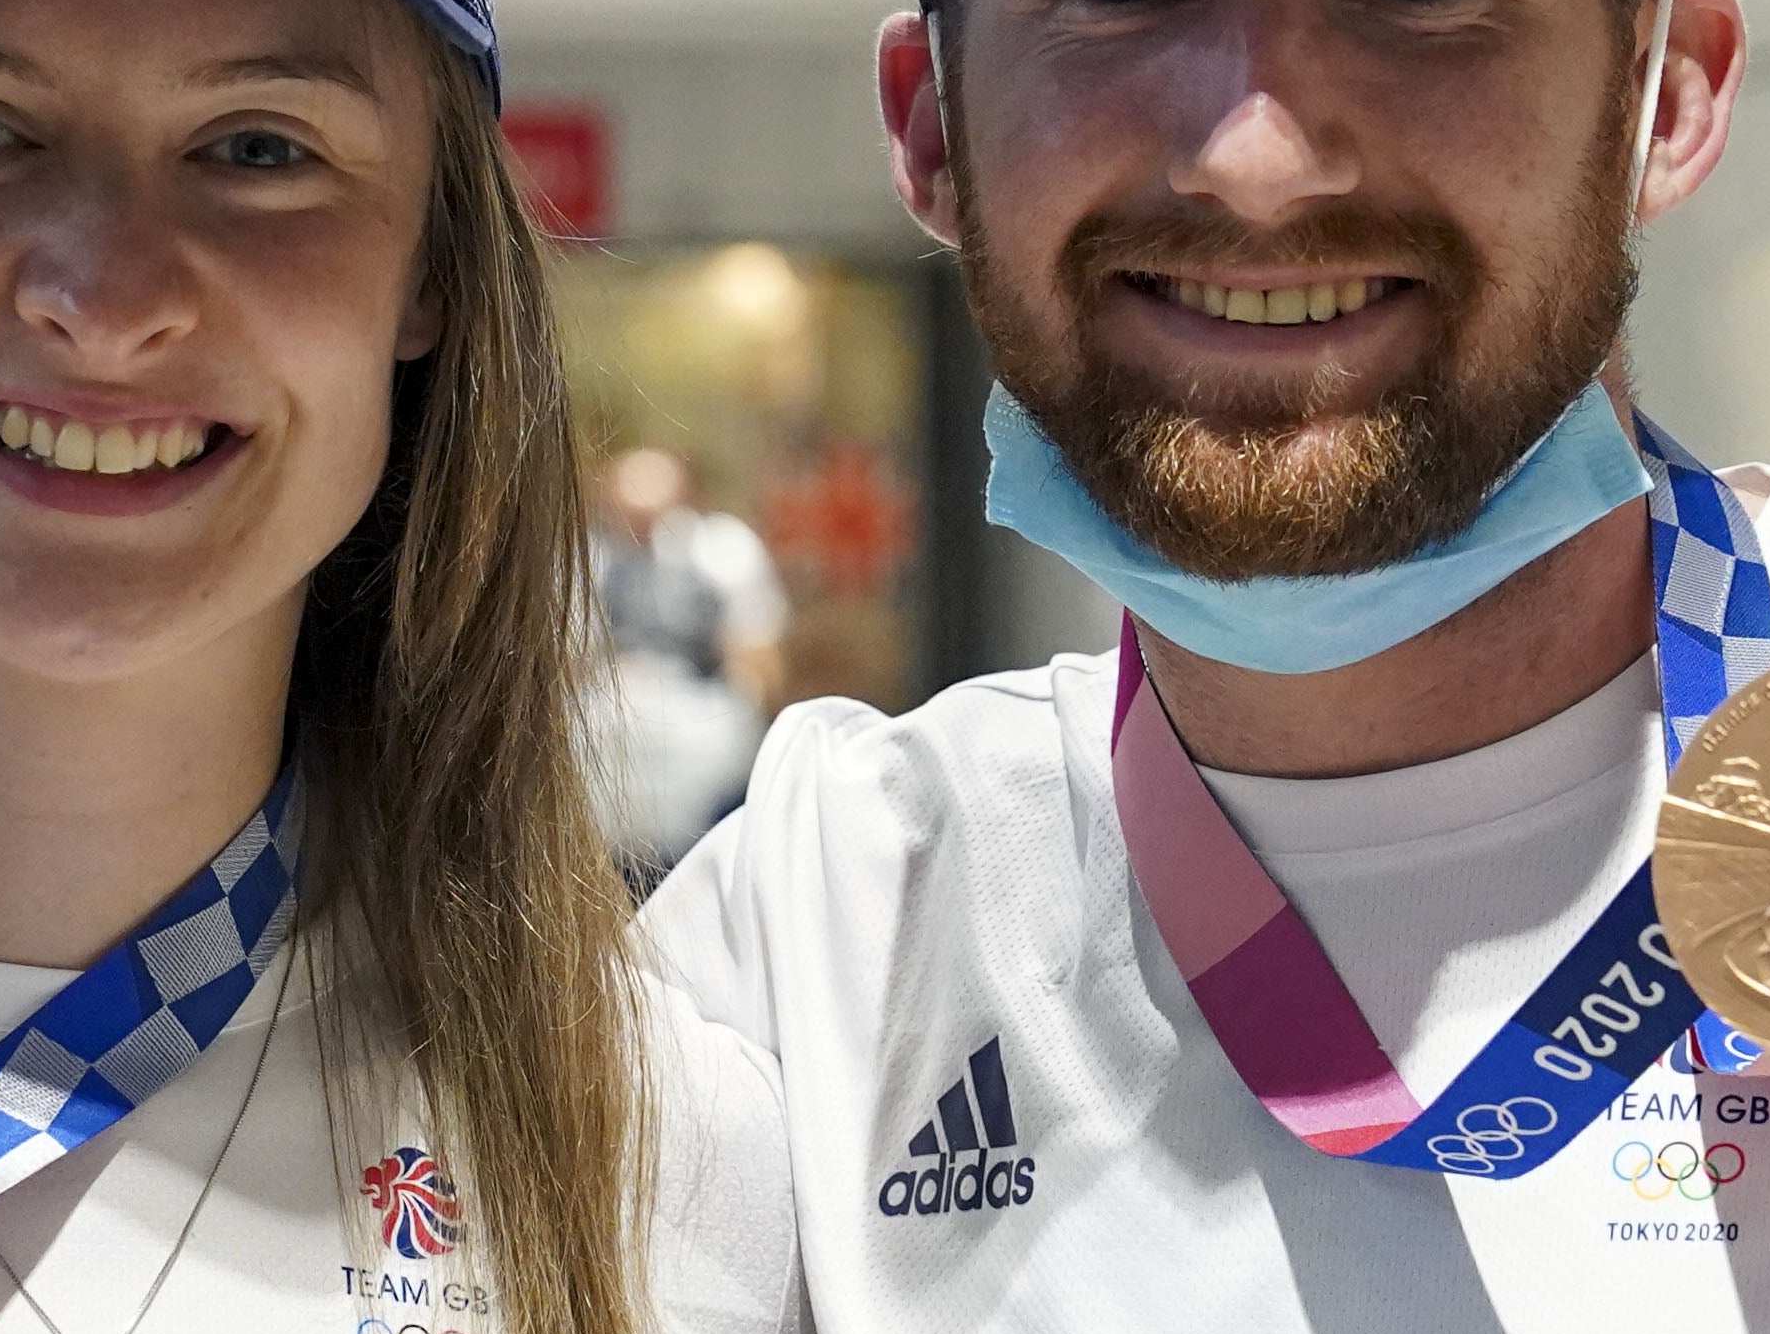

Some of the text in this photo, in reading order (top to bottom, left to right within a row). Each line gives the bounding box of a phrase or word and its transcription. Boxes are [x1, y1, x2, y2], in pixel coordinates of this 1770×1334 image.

[1533, 961, 1666, 1081] 2020
[1716, 1095, 1770, 1124] GB
[879, 1148, 1035, 1217] adidas
[1607, 1222, 1739, 1242] TOKYO 2020
[341, 1266, 488, 1315] TEAM GB
